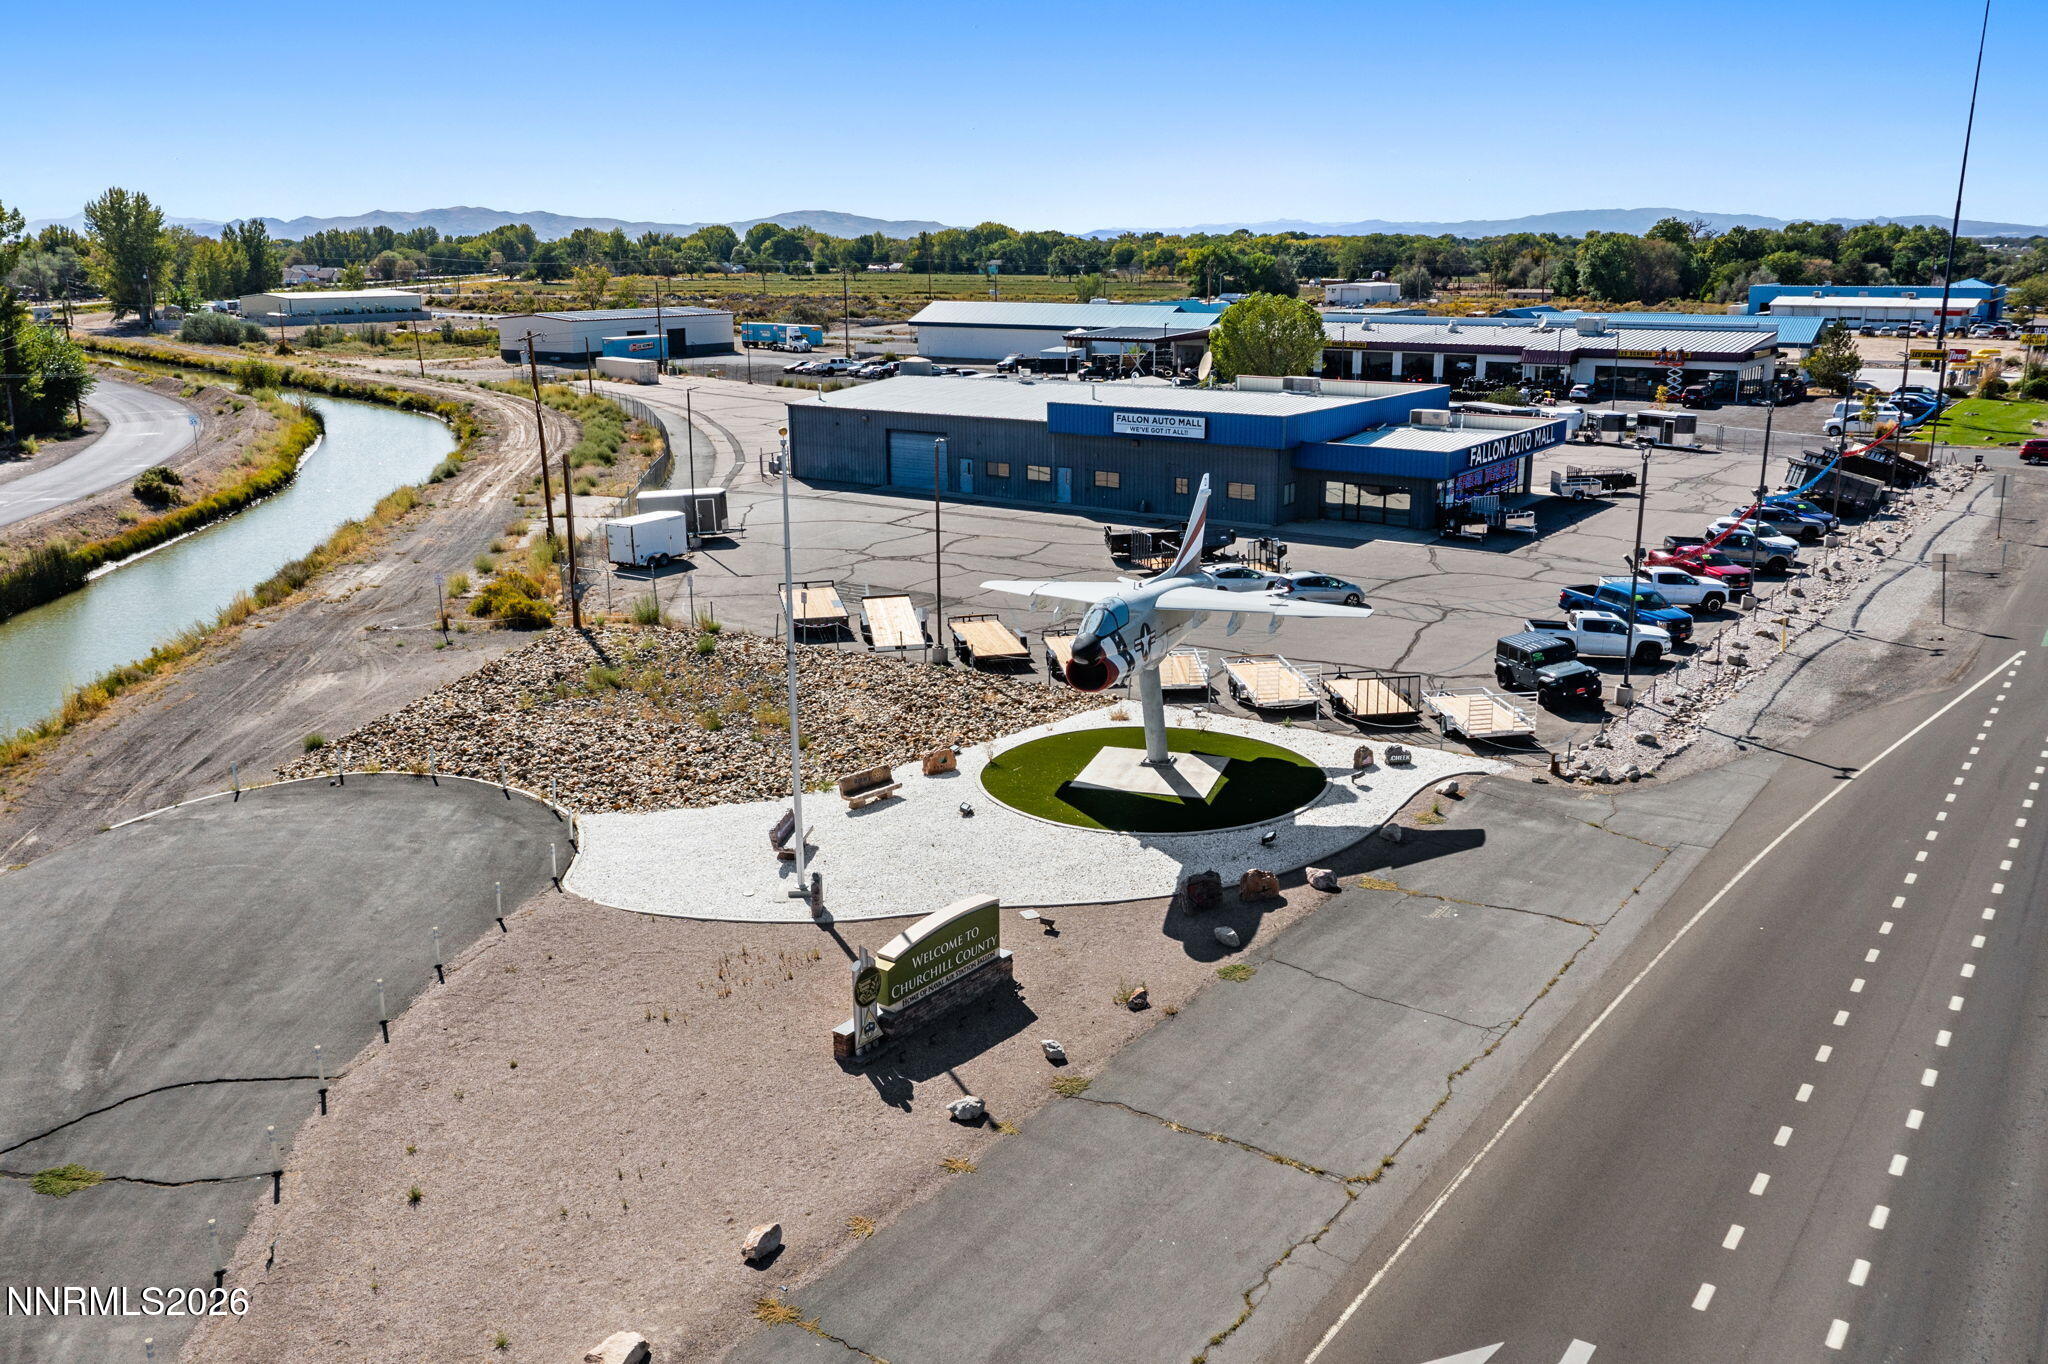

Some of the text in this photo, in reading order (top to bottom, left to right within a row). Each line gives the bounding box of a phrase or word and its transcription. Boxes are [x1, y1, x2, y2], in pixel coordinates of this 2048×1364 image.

[1950, 350, 1967, 360] Tires
[1117, 415, 1202, 427] FALLON AUTO MALL
[1470, 426, 1556, 467] FALLON AUTO MALL
[891, 935, 998, 999] CHURCHILL COUNTY
[912, 926, 980, 969] WELCOME TO
